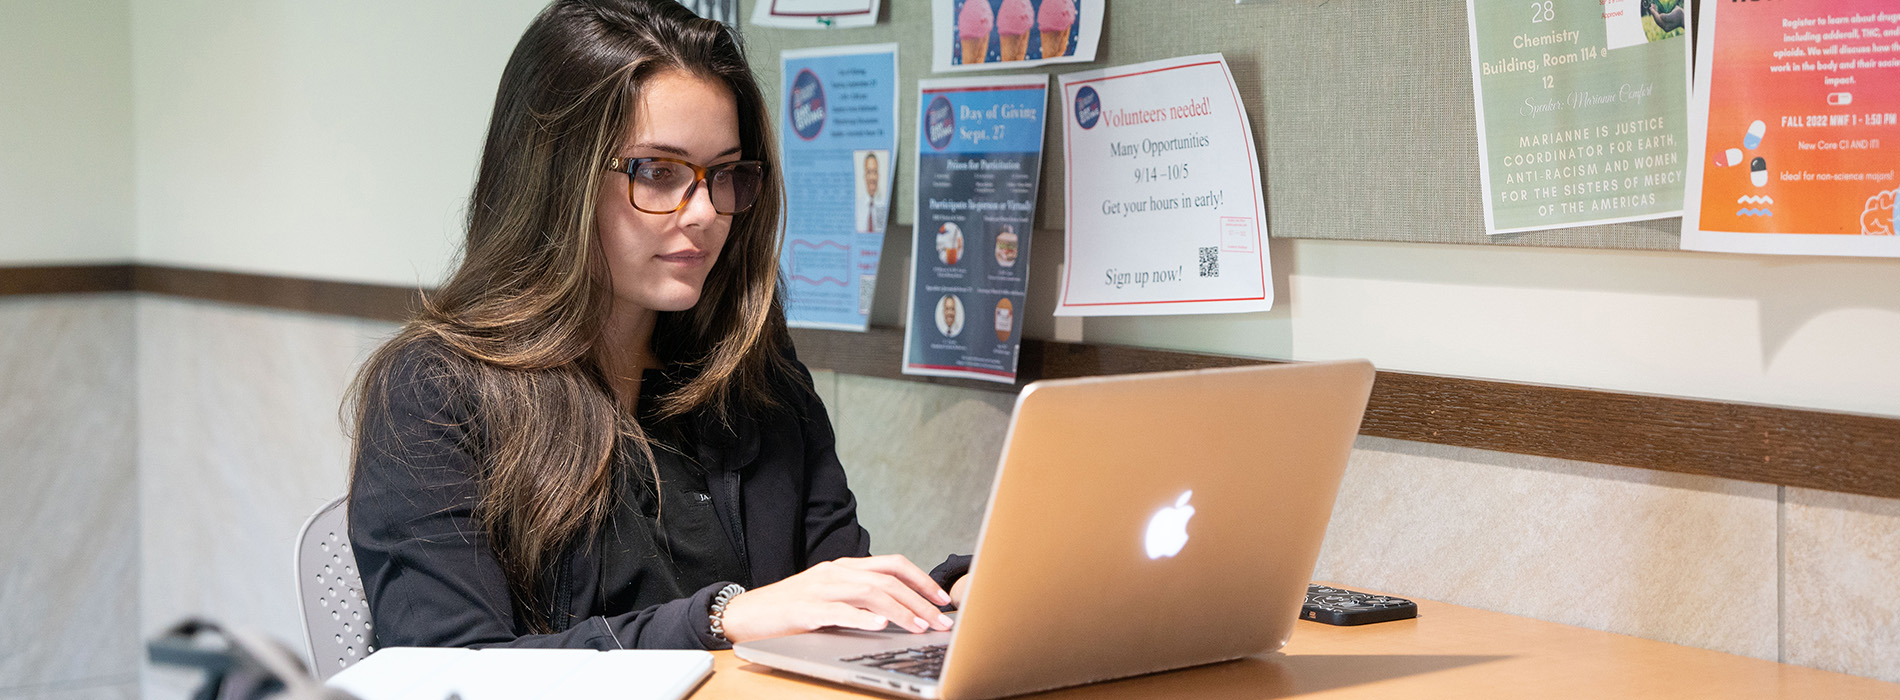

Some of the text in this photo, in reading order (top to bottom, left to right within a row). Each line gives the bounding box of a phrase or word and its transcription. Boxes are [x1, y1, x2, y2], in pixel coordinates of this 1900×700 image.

[1530, 1, 1555, 24] 28
[1601, 10, 1624, 20] Approved
[1782, 18, 1816, 30] Register
[1817, 17, 1826, 26] to
[1827, 14, 1849, 25] learn
[1850, 12, 1876, 23] about
[1513, 29, 1580, 49] Chemistry
[1783, 25, 1900, 43] including adderall, THC, and
[1773, 47, 1806, 60] opioids.
[1807, 46, 1821, 56] We
[1822, 44, 1838, 55] will
[1839, 43, 1871, 55] discuss
[1872, 41, 1889, 53] how
[1482, 48, 1608, 76] Building, Room 114 @
[1770, 57, 1900, 73] work in the body and their socia
[1542, 75, 1555, 89] 12
[1824, 76, 1856, 87] impact.
[1519, 82, 1654, 119] Speaker: Marianne Comfort
[960, 104, 983, 124] Day
[985, 103, 999, 120] of
[1001, 103, 1038, 122] Giving
[1102, 96, 1212, 128] Volunteers needed!
[1781, 115, 1803, 128] FALL
[1806, 115, 1828, 127] 2022
[1829, 114, 1850, 126] MWF
[1852, 114, 1857, 126] 1
[1864, 113, 1882, 126] 1:50
[1883, 113, 1898, 125] PM
[960, 124, 1005, 145] Sept. 27
[1519, 116, 1664, 148] MARIANNE IS JUSTICE
[1110, 132, 1210, 160] Many Opportunities
[1503, 134, 1678, 167] COORDINATOR FOR EARTH,
[1798, 140, 1816, 150] New
[1817, 139, 1838, 150] Core
[1850, 139, 1869, 149] AND
[1134, 166, 1157, 184] 9/14
[1506, 152, 1678, 185] ANTI-RACISM AND WOMEN
[1780, 169, 1895, 183] Ideal for non-science majors!
[1501, 170, 1682, 202] FOR THE SISTERS OF MERCY
[1102, 189, 1224, 217] Get your hours in early!
[1538, 192, 1656, 218] OF THE AMERICAS
[1105, 264, 1183, 289] Sign up now!
